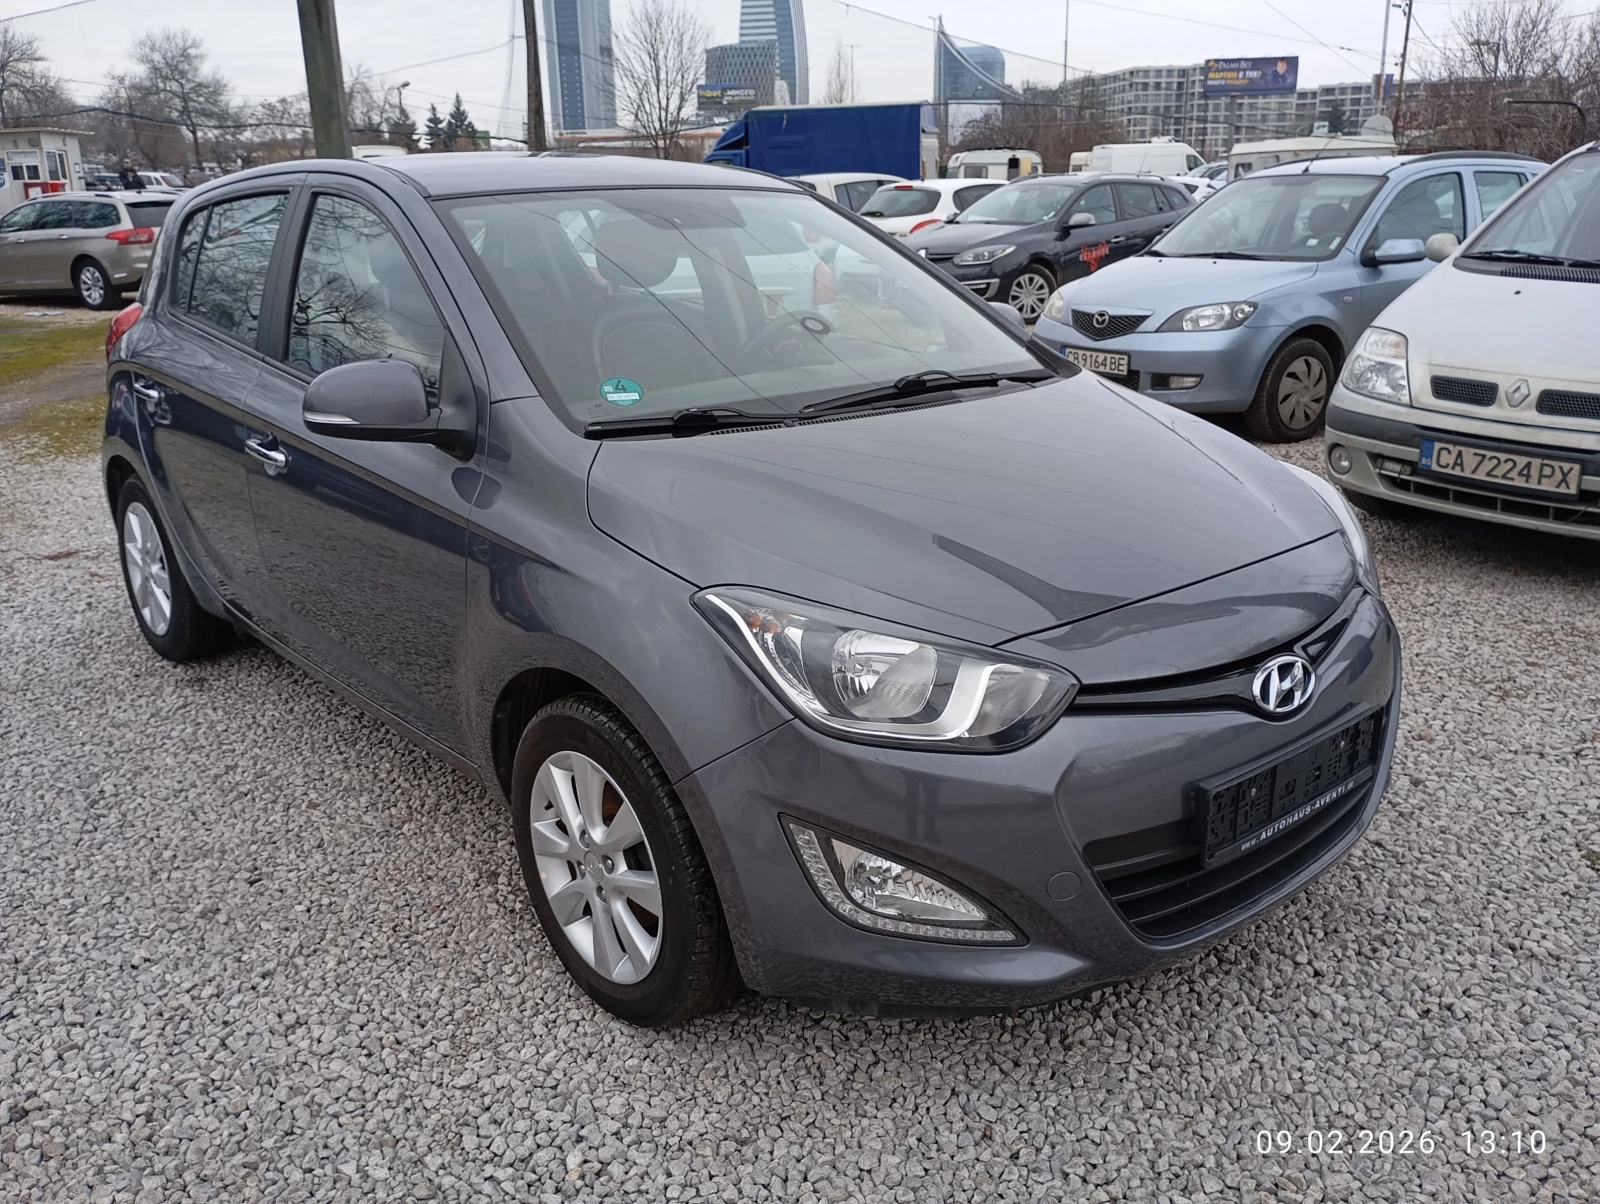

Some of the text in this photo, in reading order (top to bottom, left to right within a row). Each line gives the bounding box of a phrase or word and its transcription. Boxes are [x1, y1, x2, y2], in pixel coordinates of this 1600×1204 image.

[1081, 353, 1108, 370] 9164
[1109, 356, 1126, 373] BE
[1436, 446, 1575, 490] CA 7224 PX
